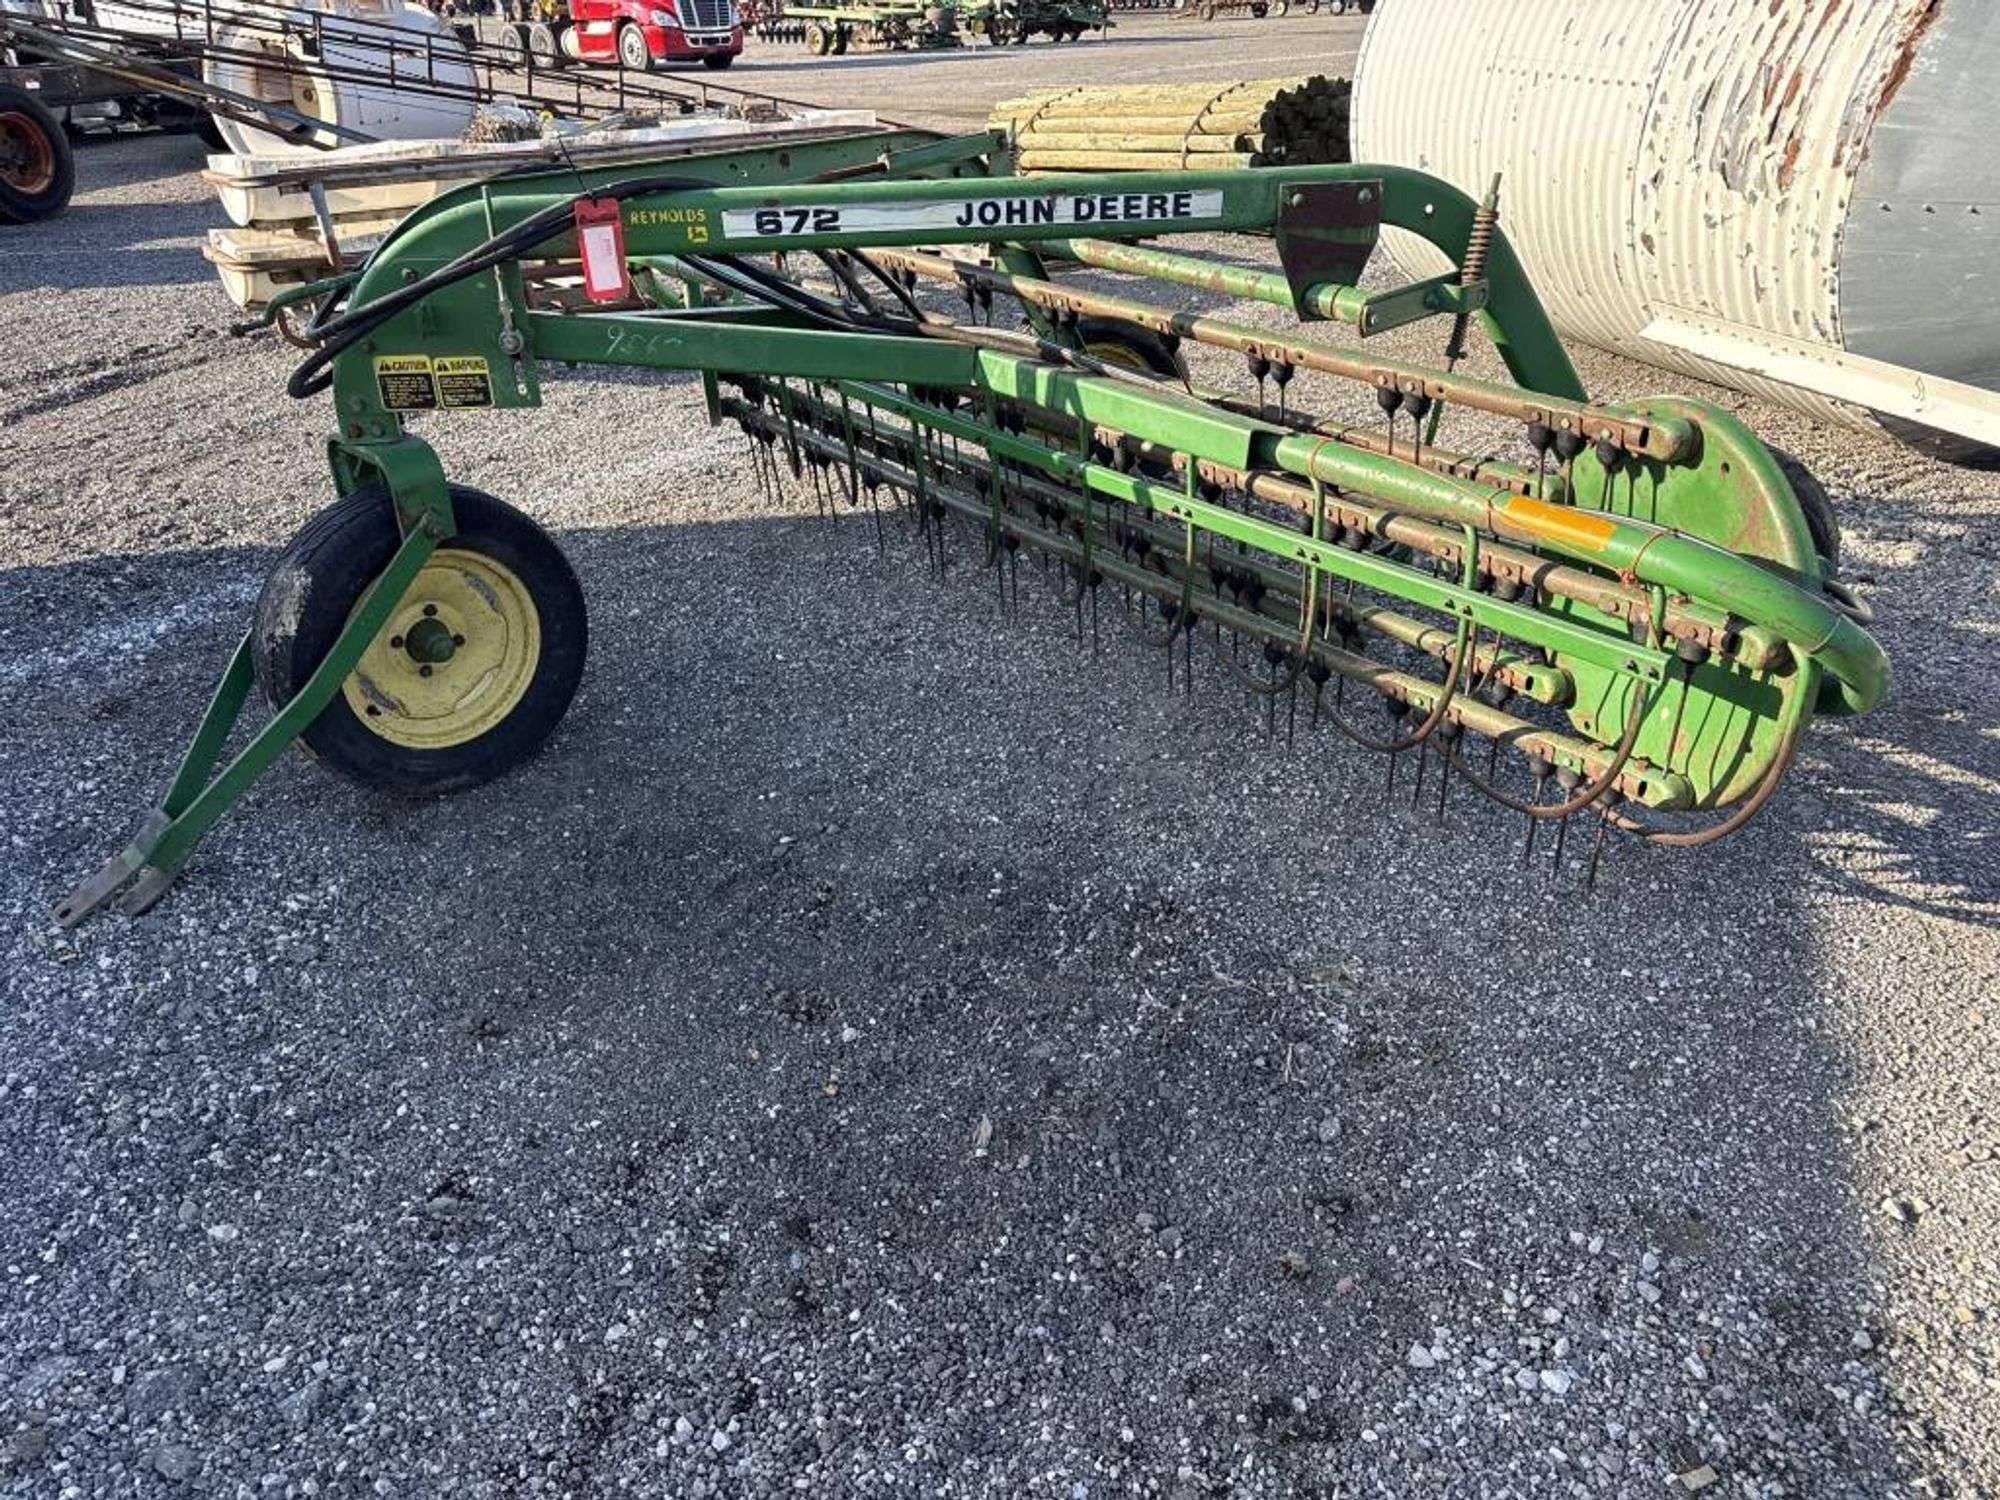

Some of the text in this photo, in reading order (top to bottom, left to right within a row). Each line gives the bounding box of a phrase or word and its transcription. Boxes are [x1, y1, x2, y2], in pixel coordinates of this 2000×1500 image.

[630, 209, 707, 224] REYNOLDS
[755, 192, 1193, 235] 672 JOHN DEERE
[392, 360, 427, 370] CAUTION
[451, 360, 486, 370] WARNING
